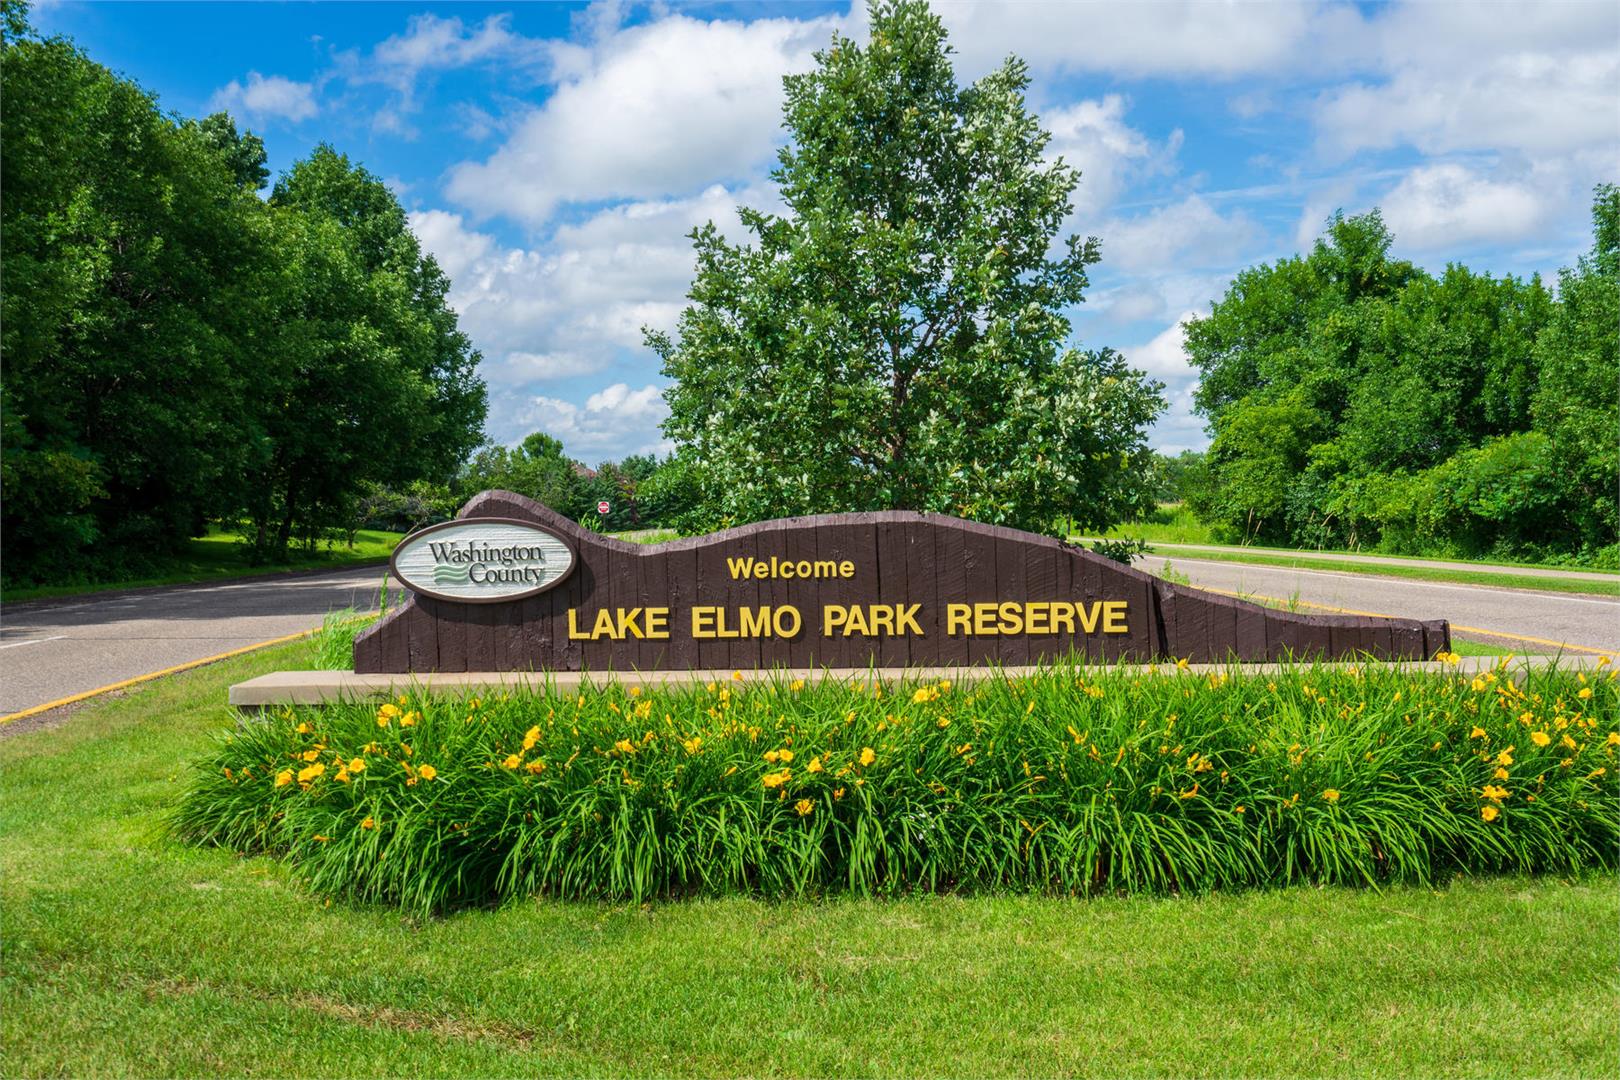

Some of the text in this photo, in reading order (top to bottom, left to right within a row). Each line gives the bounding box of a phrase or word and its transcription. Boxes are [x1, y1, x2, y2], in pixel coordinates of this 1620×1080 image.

[428, 541, 543, 566] Washington
[469, 562, 543, 585] County
[727, 557, 855, 579] Welcome
[568, 601, 1128, 640] LAKE ELMO PARK RESERVE
